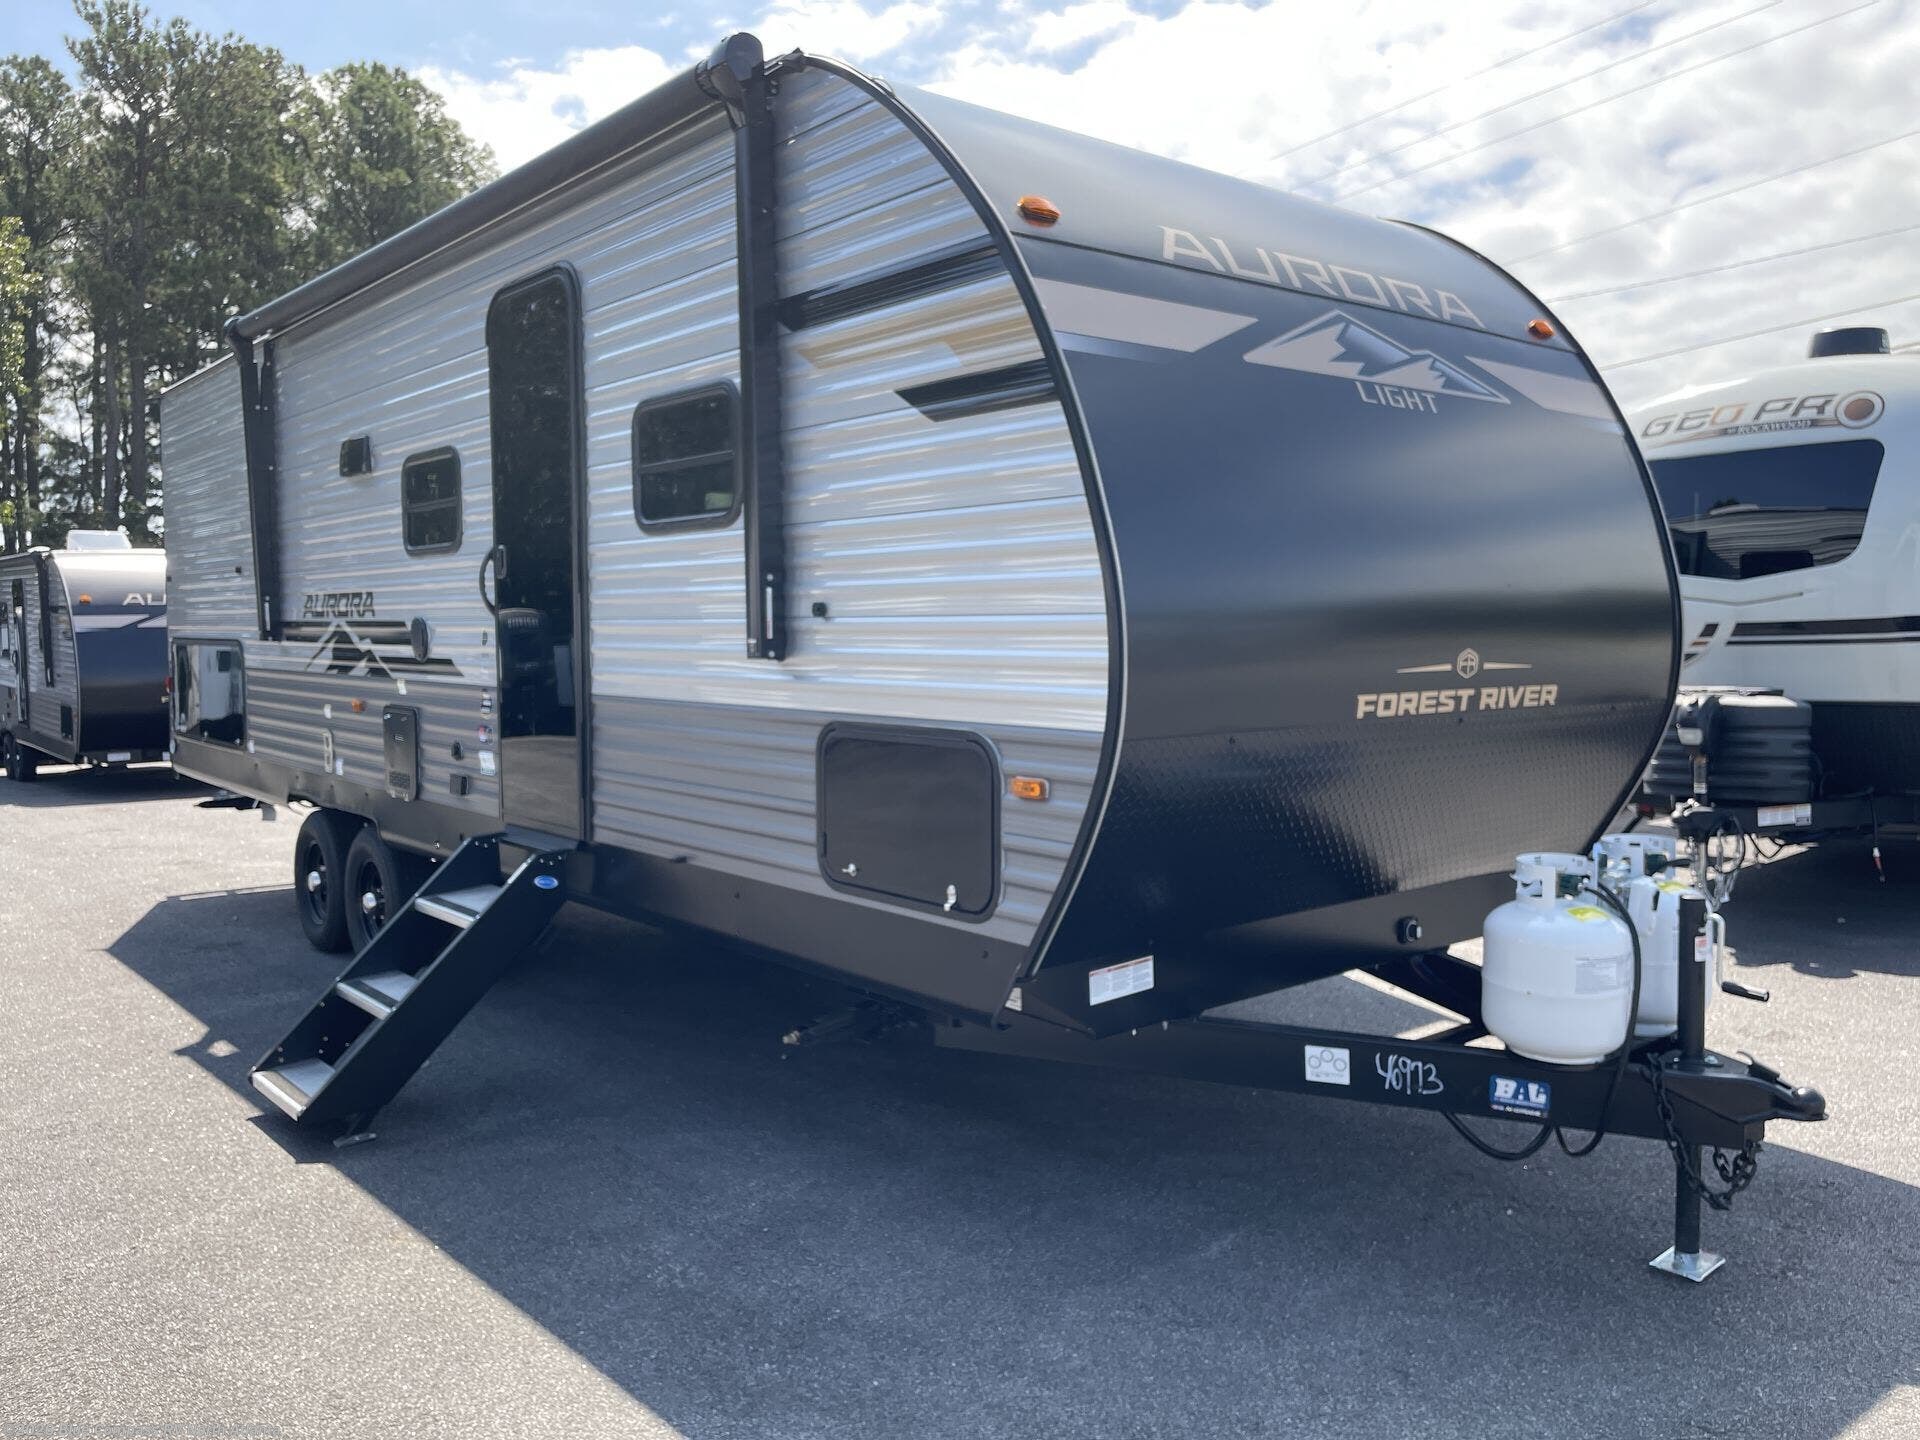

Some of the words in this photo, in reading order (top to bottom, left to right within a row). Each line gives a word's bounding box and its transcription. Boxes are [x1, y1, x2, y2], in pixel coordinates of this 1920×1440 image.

[1159, 225, 1488, 329] AURORA
[1355, 381, 1438, 413] LIGHT
[1641, 403, 1746, 438] GEO
[303, 591, 376, 619] AURORA
[1356, 688, 1475, 720] FOREST
[1479, 684, 1558, 711] RIVER
